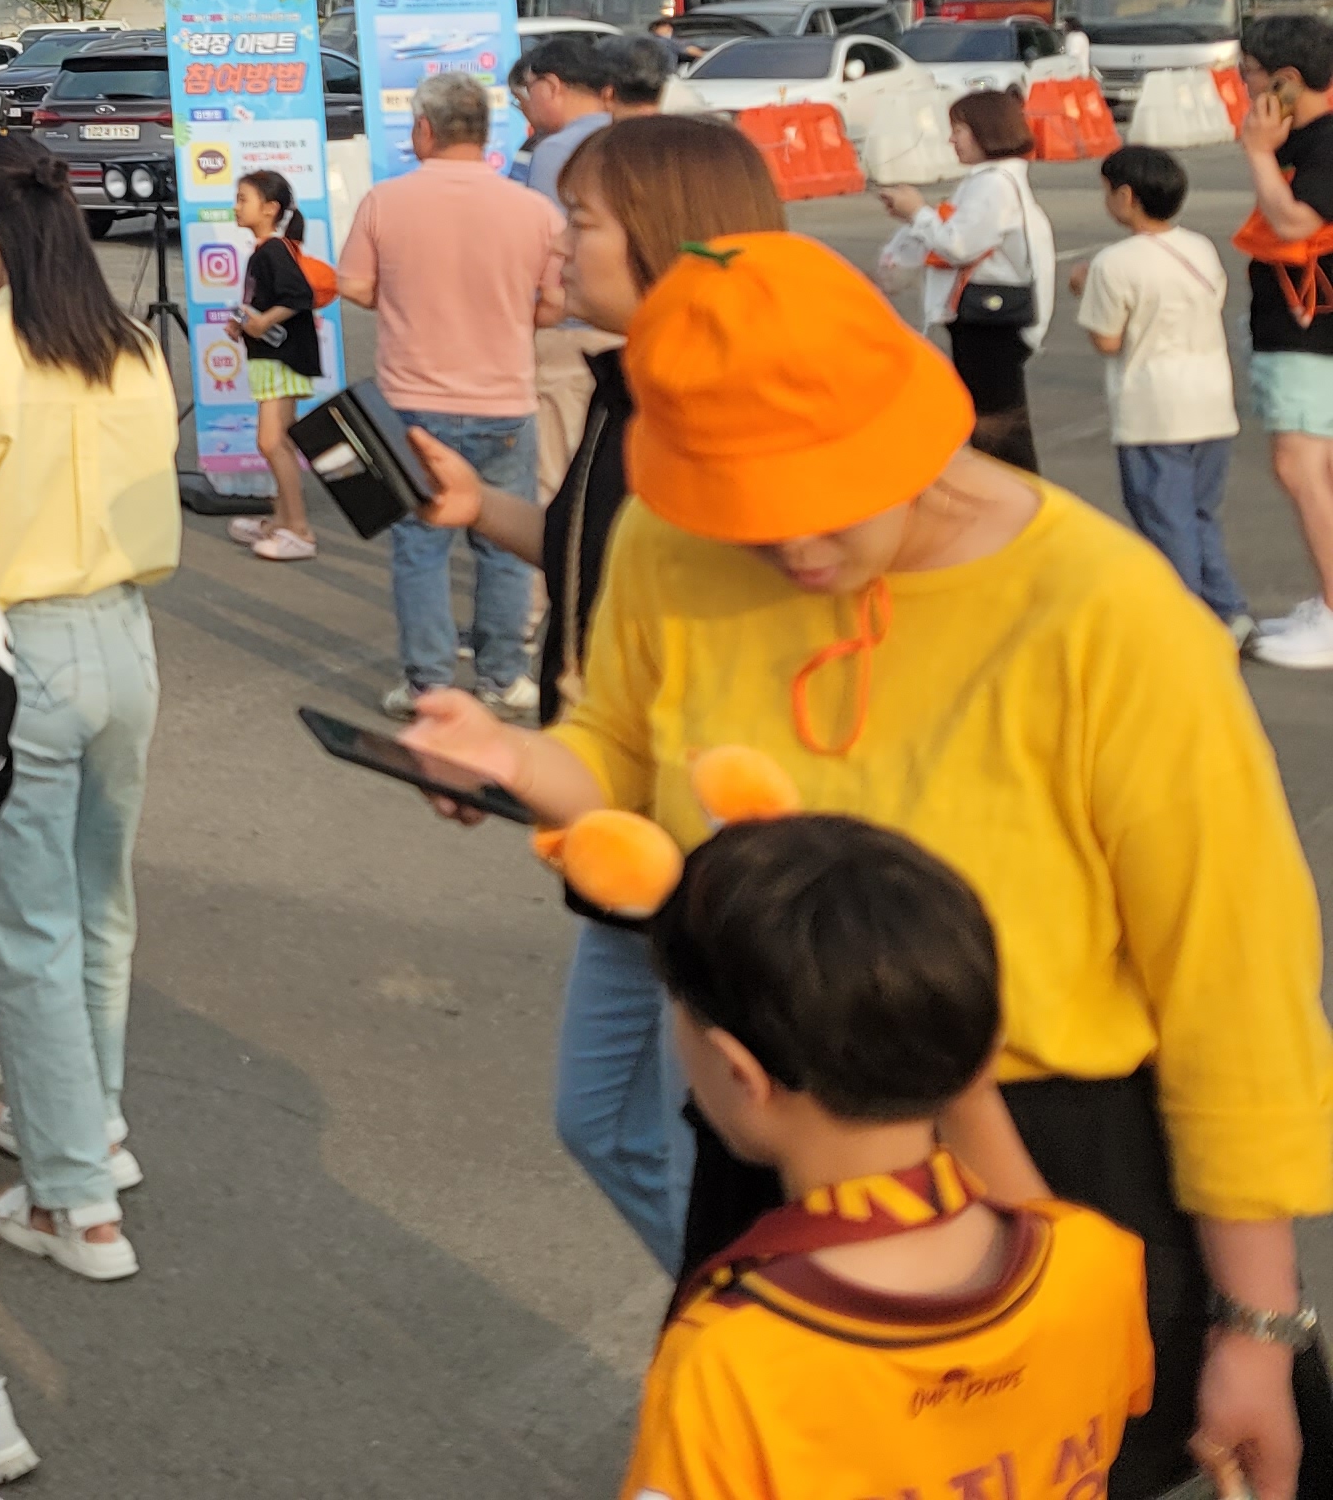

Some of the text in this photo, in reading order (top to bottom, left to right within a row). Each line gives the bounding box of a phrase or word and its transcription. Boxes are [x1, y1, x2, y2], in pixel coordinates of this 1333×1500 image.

[189, 31, 297, 56] 현장 이벤트
[184, 61, 307, 96] 참여방법
